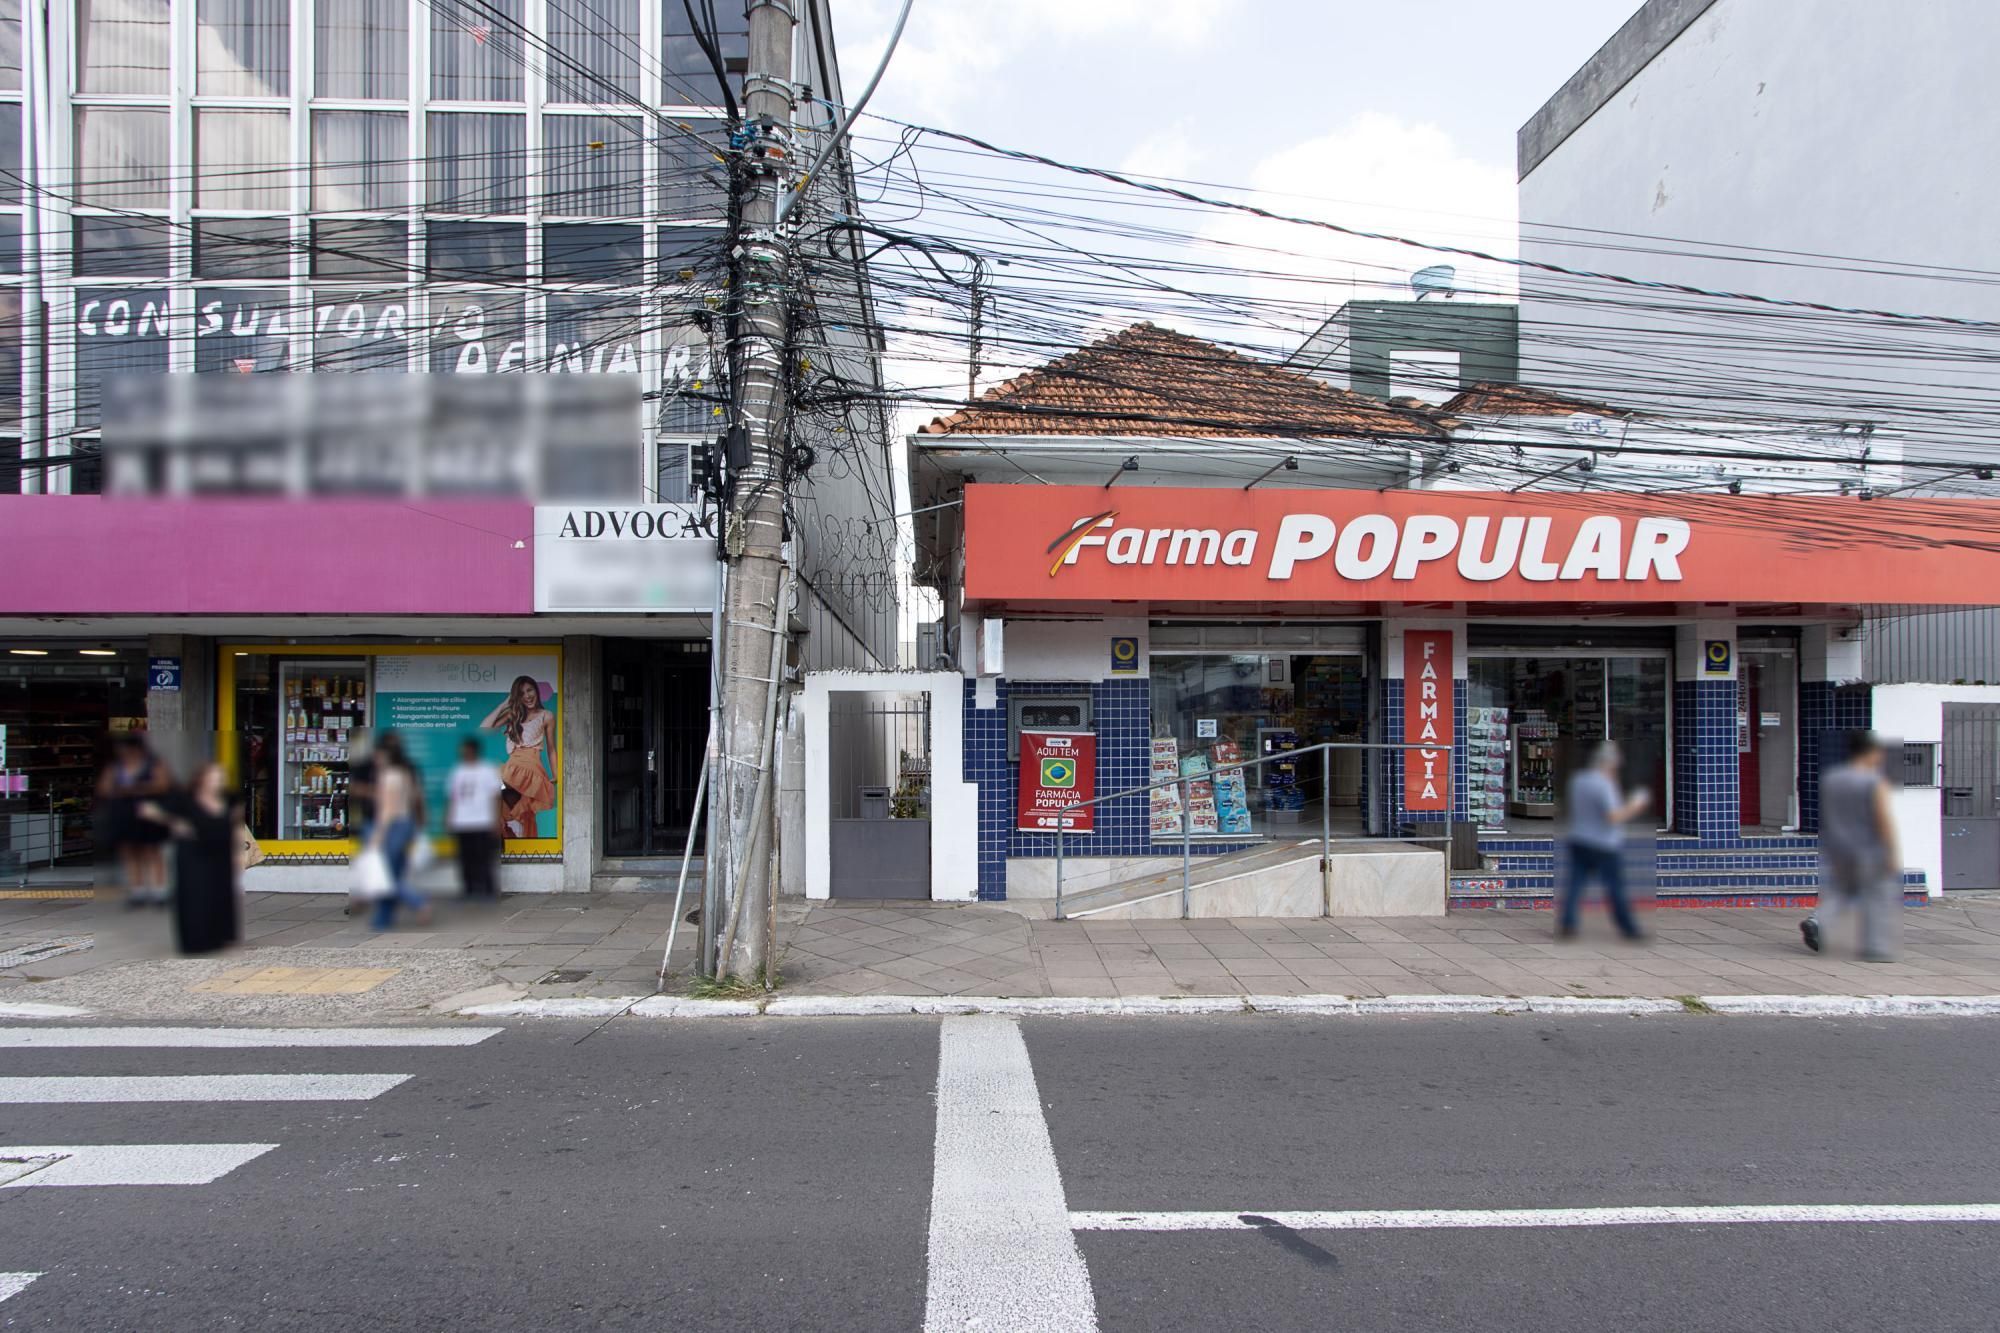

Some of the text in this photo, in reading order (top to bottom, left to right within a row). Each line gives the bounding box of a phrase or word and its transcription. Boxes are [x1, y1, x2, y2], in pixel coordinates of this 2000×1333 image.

[1063, 514, 1691, 582] Farma POPULAR
[1420, 641, 1438, 799] FARMÁCIA
[1738, 667, 1747, 747] Ban24Horas
[1036, 747, 1079, 757] AQUI TEM
[1035, 789, 1081, 799] FARMÁCIA
